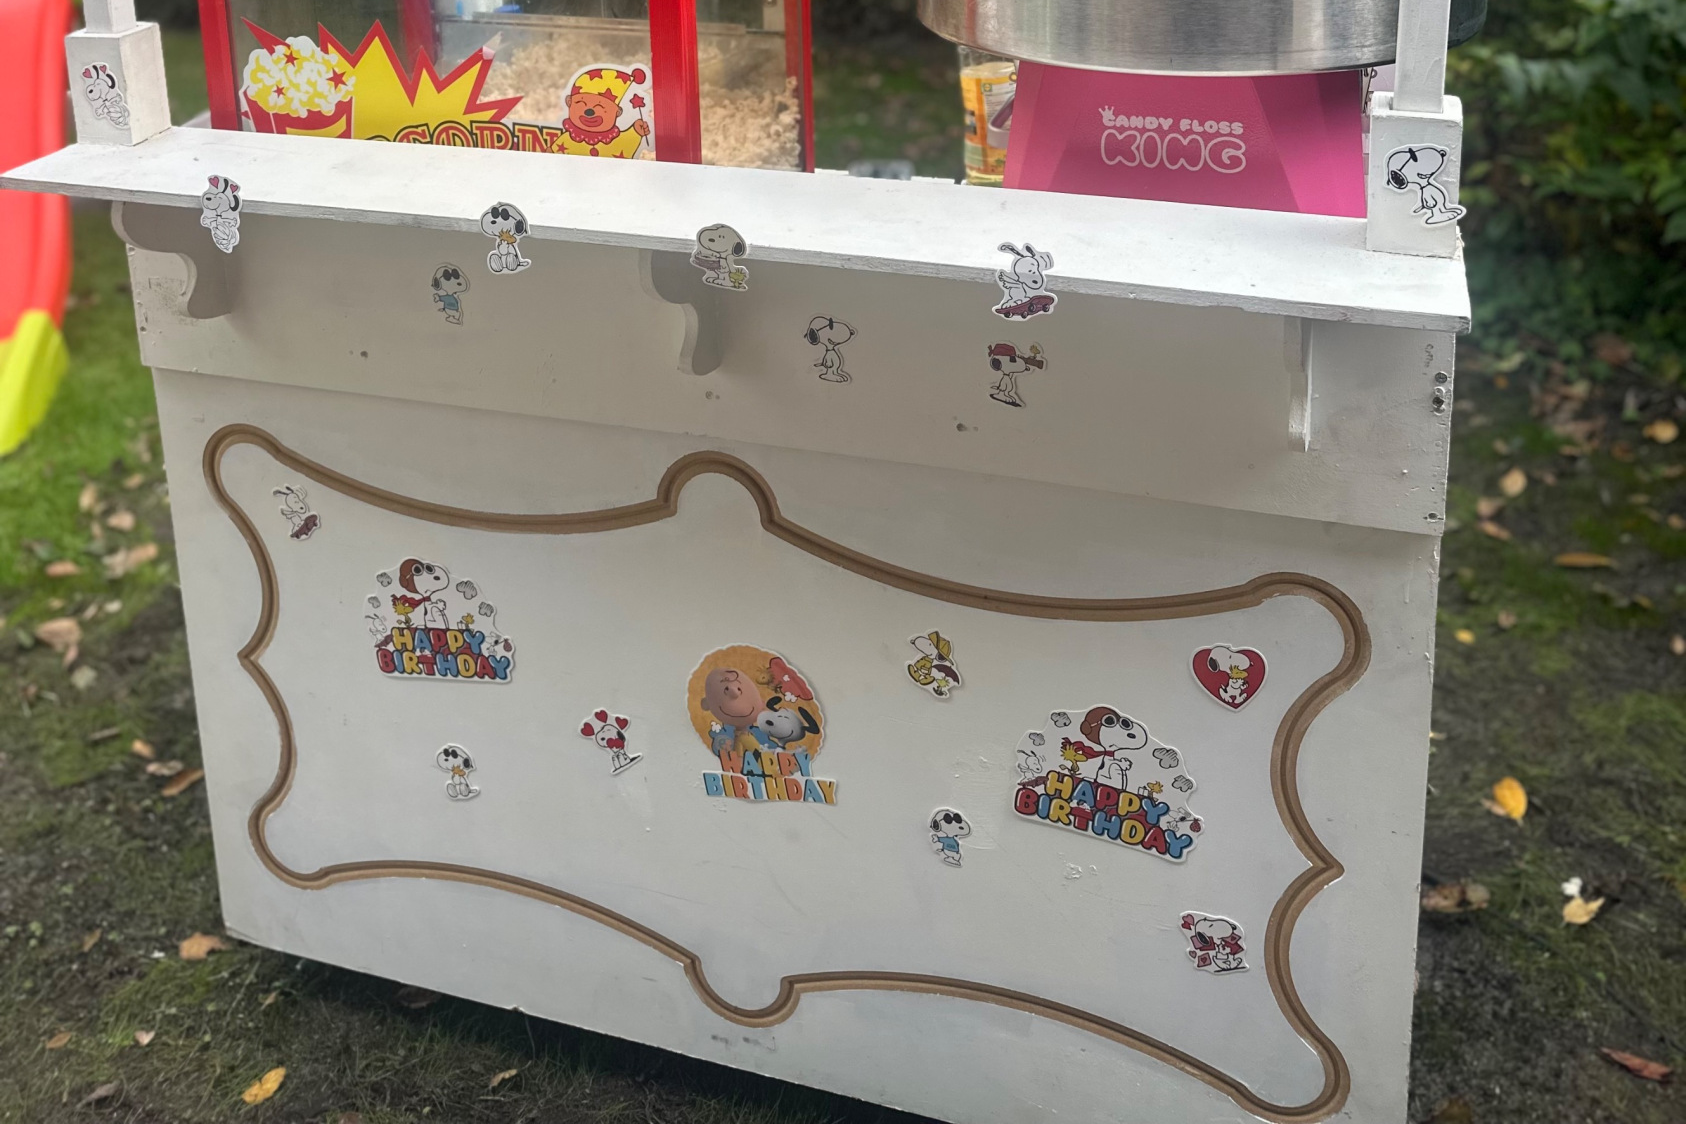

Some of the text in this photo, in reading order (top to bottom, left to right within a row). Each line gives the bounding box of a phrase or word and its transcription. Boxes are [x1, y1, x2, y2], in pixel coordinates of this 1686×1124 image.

[1102, 113, 1244, 135] CANDY FLOSS
[1101, 129, 1247, 174] KING
[391, 626, 486, 656] HAPPY
[376, 648, 511, 680] BIRTHDAY
[718, 748, 812, 778] HAPPY
[703, 772, 837, 805] BIRTHDAY
[1044, 769, 1170, 825] HAPPY
[1014, 787, 1194, 860] BIRTHDAY
